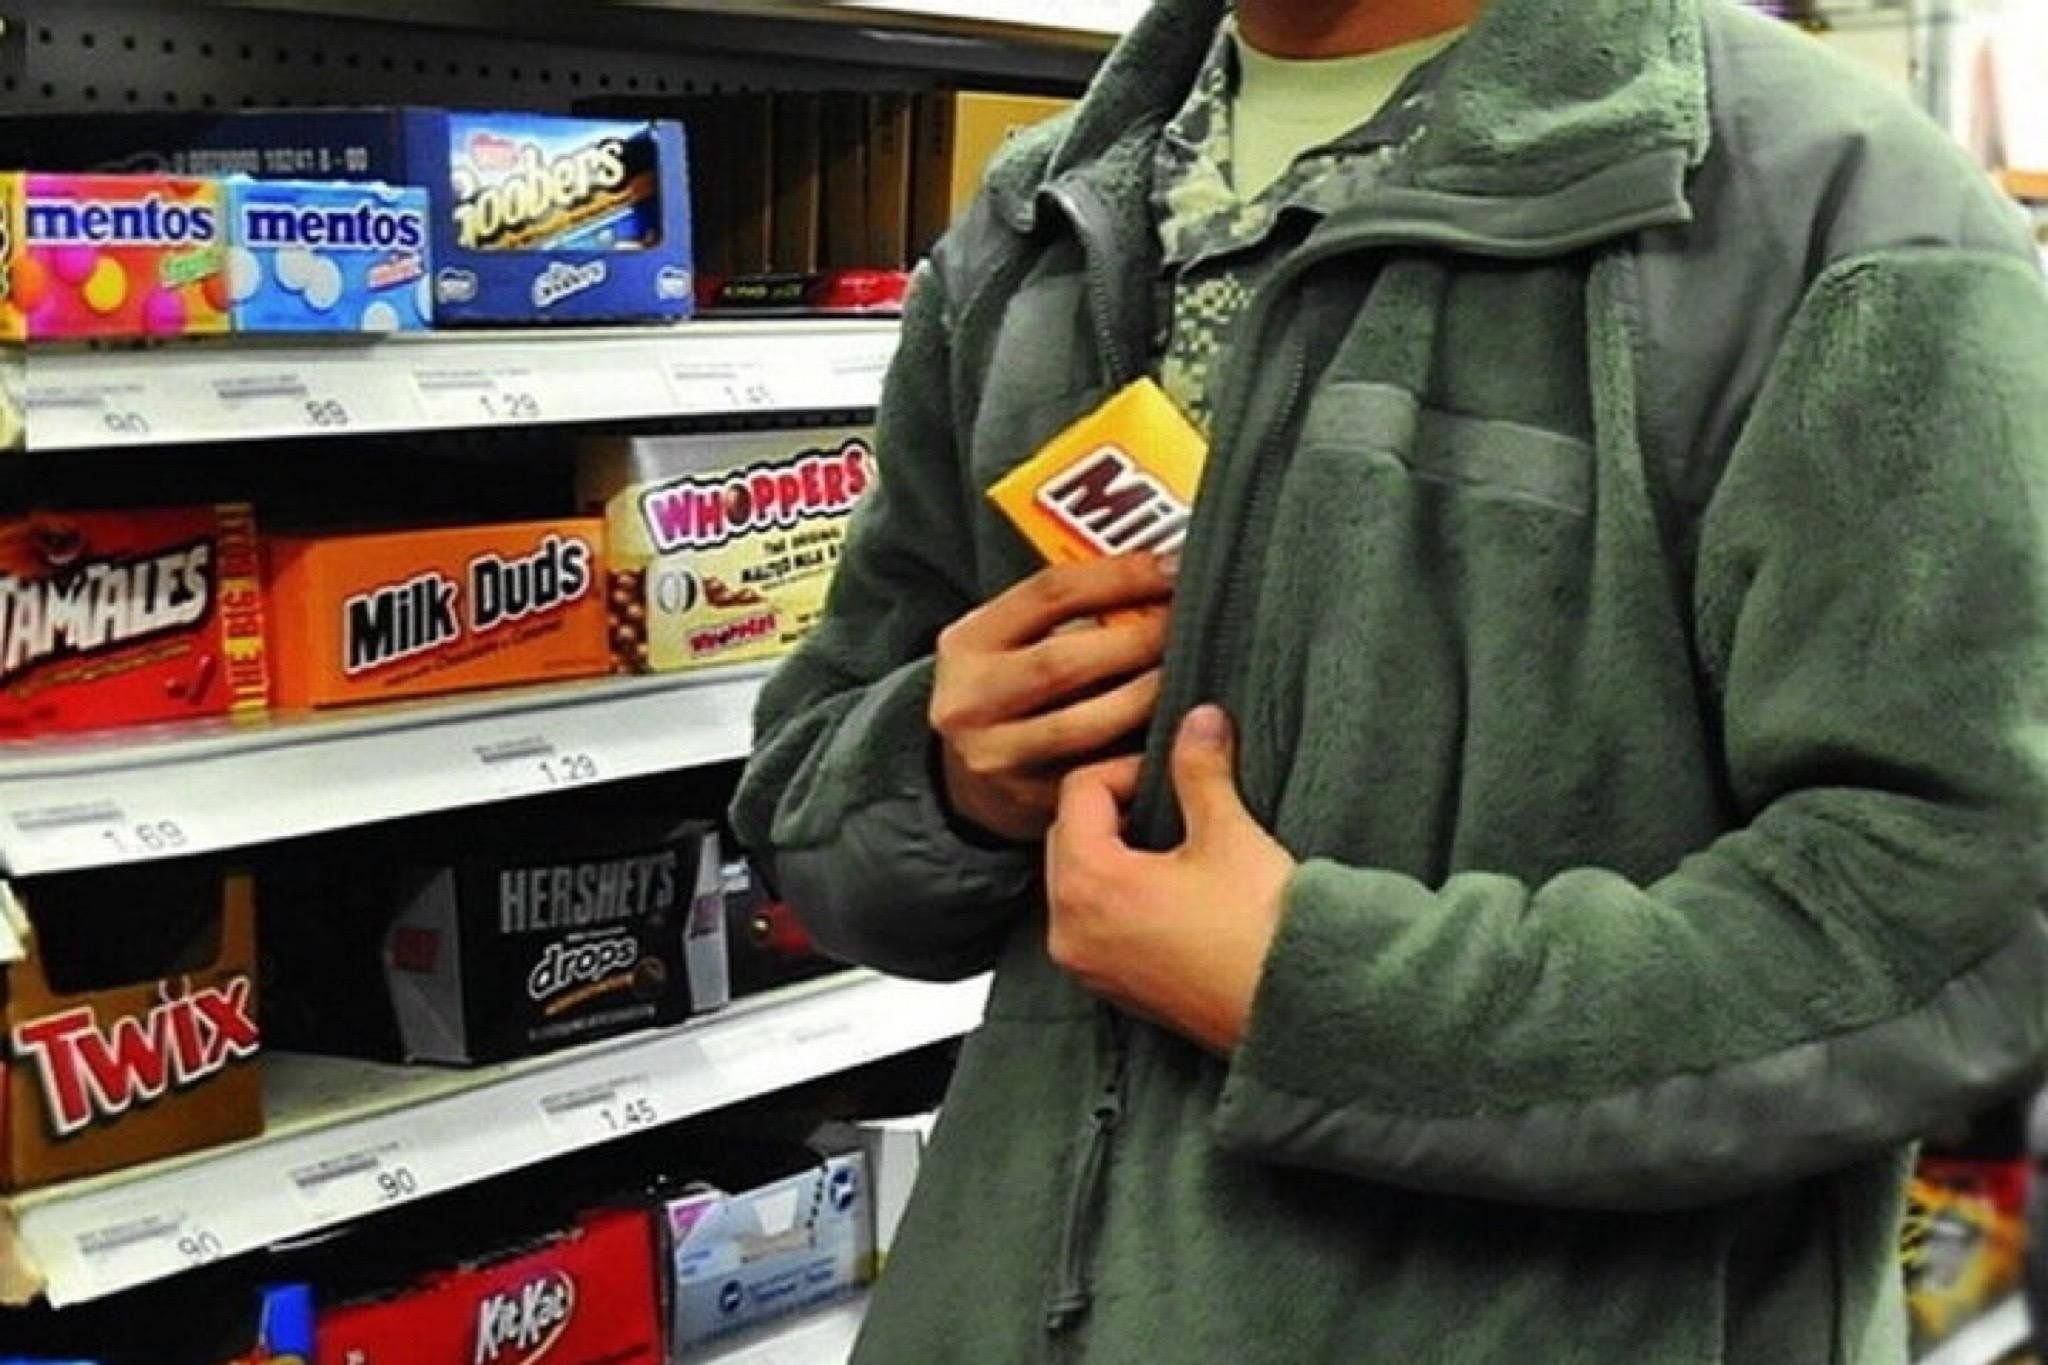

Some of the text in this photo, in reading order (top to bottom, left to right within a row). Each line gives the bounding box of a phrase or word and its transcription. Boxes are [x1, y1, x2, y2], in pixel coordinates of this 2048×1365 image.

[25, 198, 215, 241] mentos
[245, 203, 421, 248] mentos
[646, 446, 872, 544] WHOPPERS
[1044, 448, 1192, 554] Mil
[346, 573, 458, 673] Milk
[471, 534, 590, 630] Duds
[501, 851, 676, 934] HERSHEY'S
[528, 937, 638, 1000] drops
